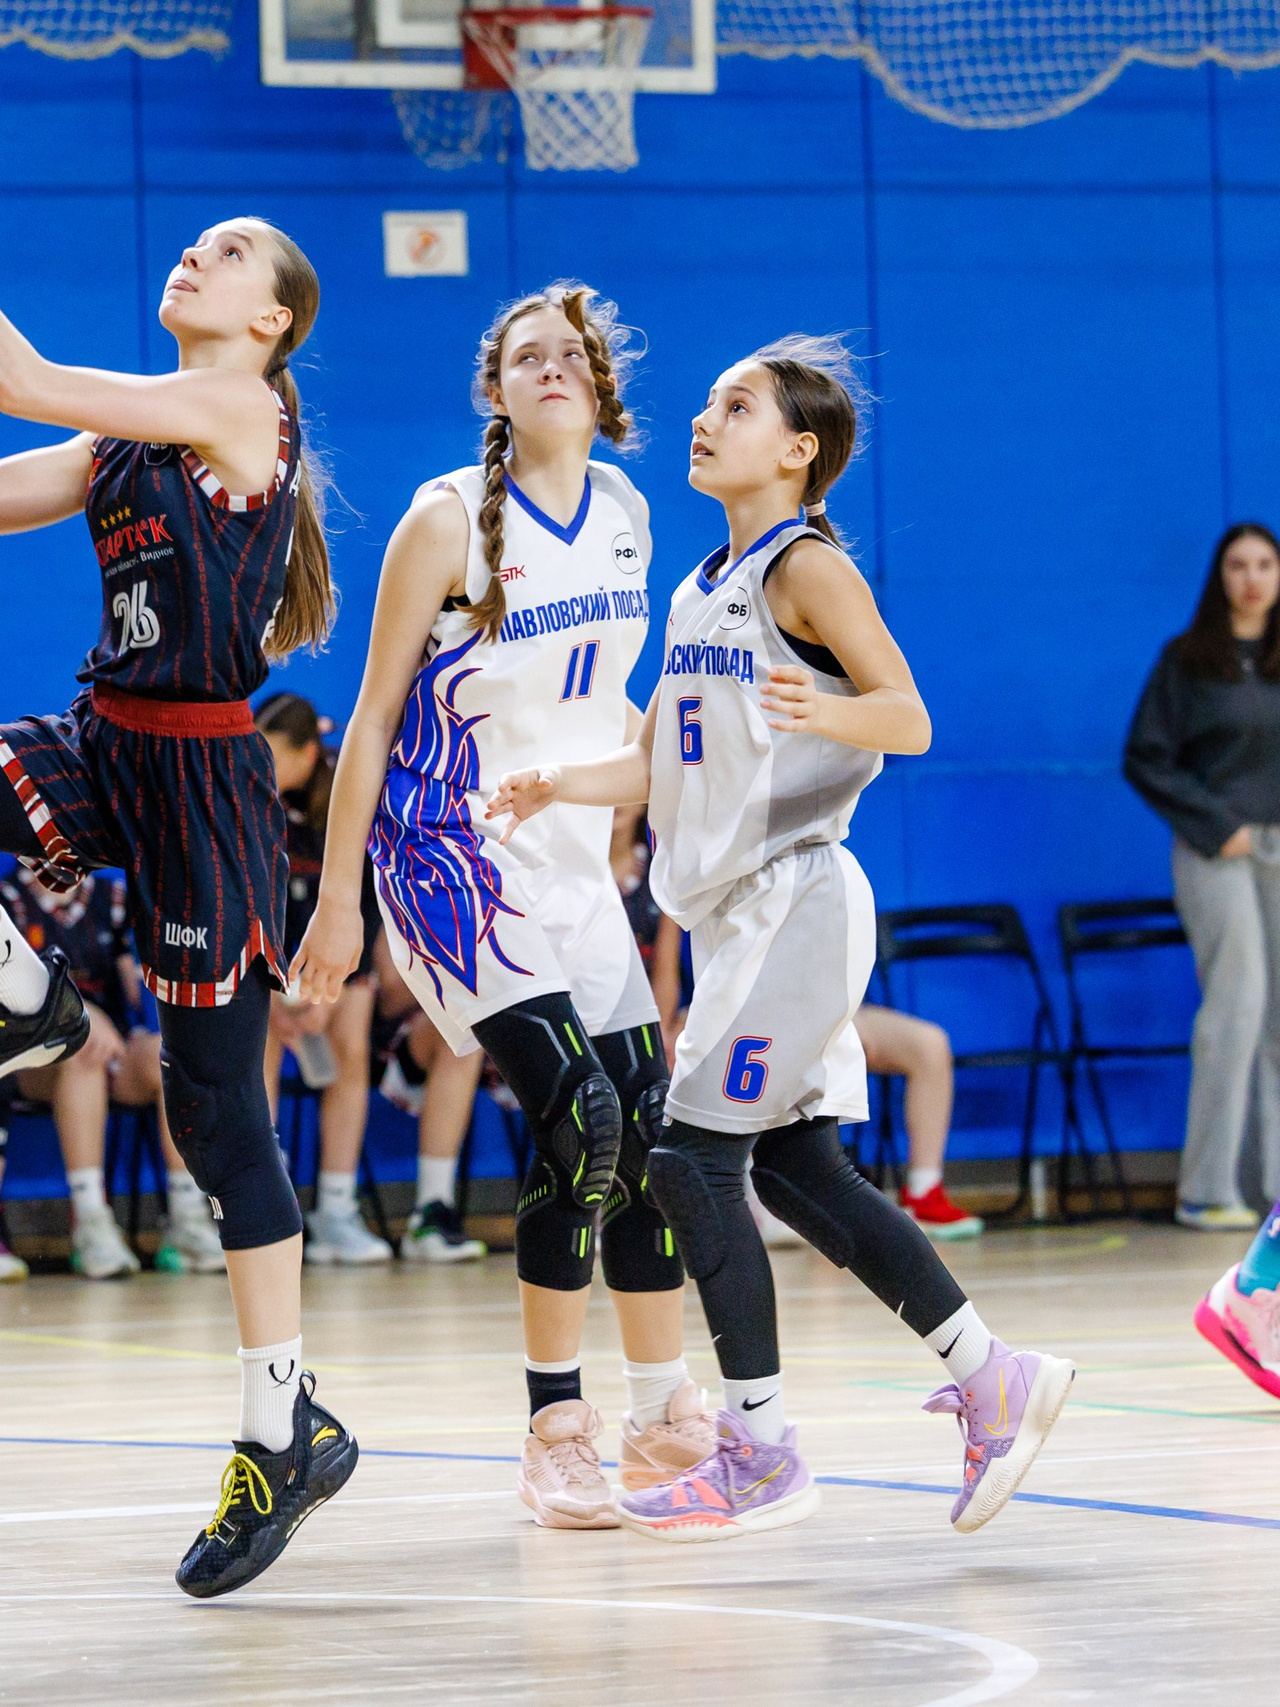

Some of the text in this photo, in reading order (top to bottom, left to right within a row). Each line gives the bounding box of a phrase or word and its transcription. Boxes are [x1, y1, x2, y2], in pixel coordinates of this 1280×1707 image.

[112, 580, 161, 658] 26
[500, 585, 611, 643] ПАВЛОВСКИЙ
[558, 640, 601, 704] 11
[677, 696, 704, 766] 6
[165, 922, 208, 950] ШФК
[722, 1035, 773, 1104] 6
